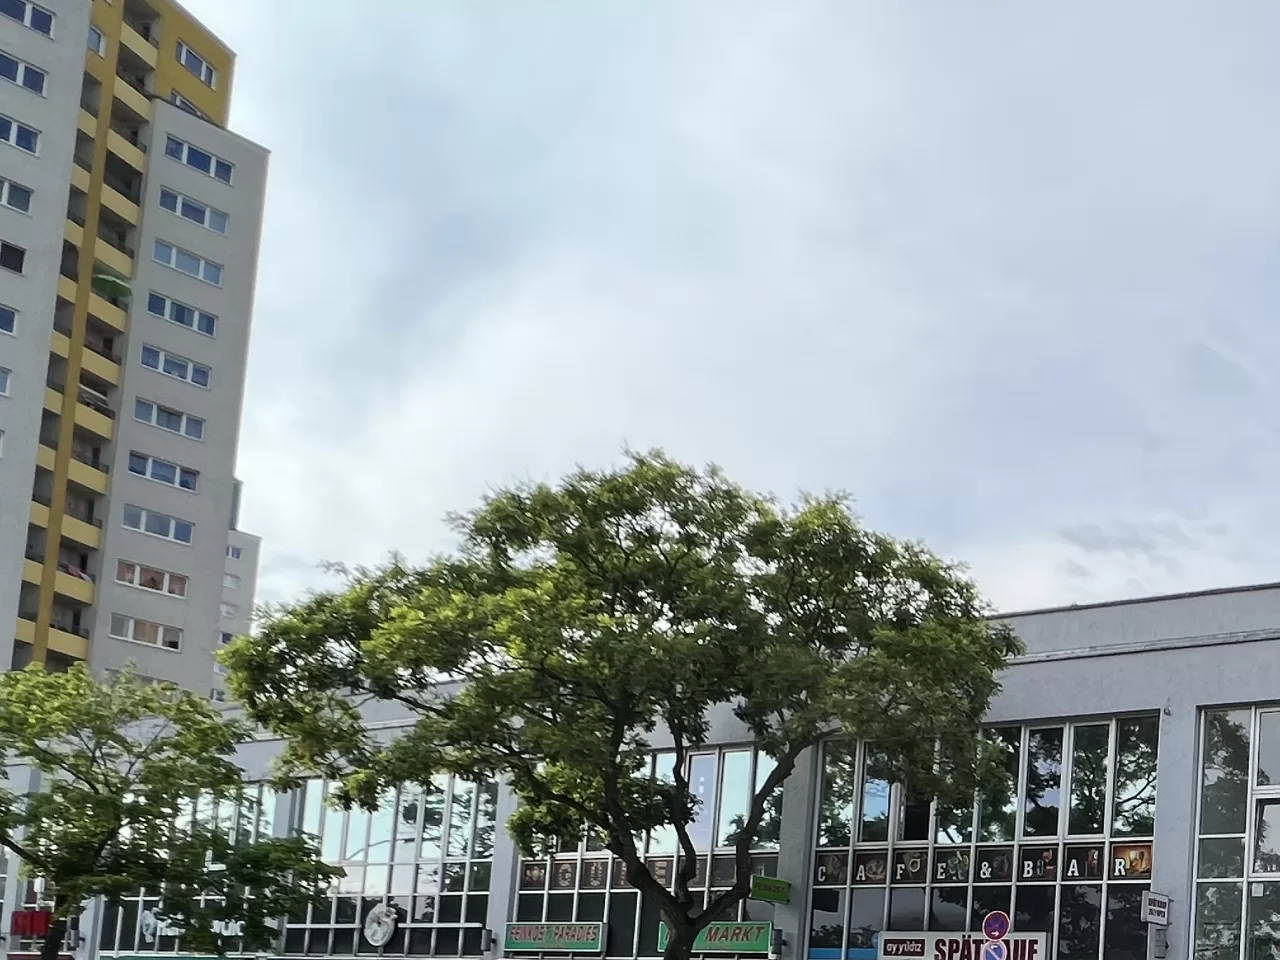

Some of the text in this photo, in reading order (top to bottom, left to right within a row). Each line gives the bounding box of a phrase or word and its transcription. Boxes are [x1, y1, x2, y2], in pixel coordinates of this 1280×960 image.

[817, 856, 1127, 883] CAFE & BAR
[705, 925, 765, 944] MARKT
